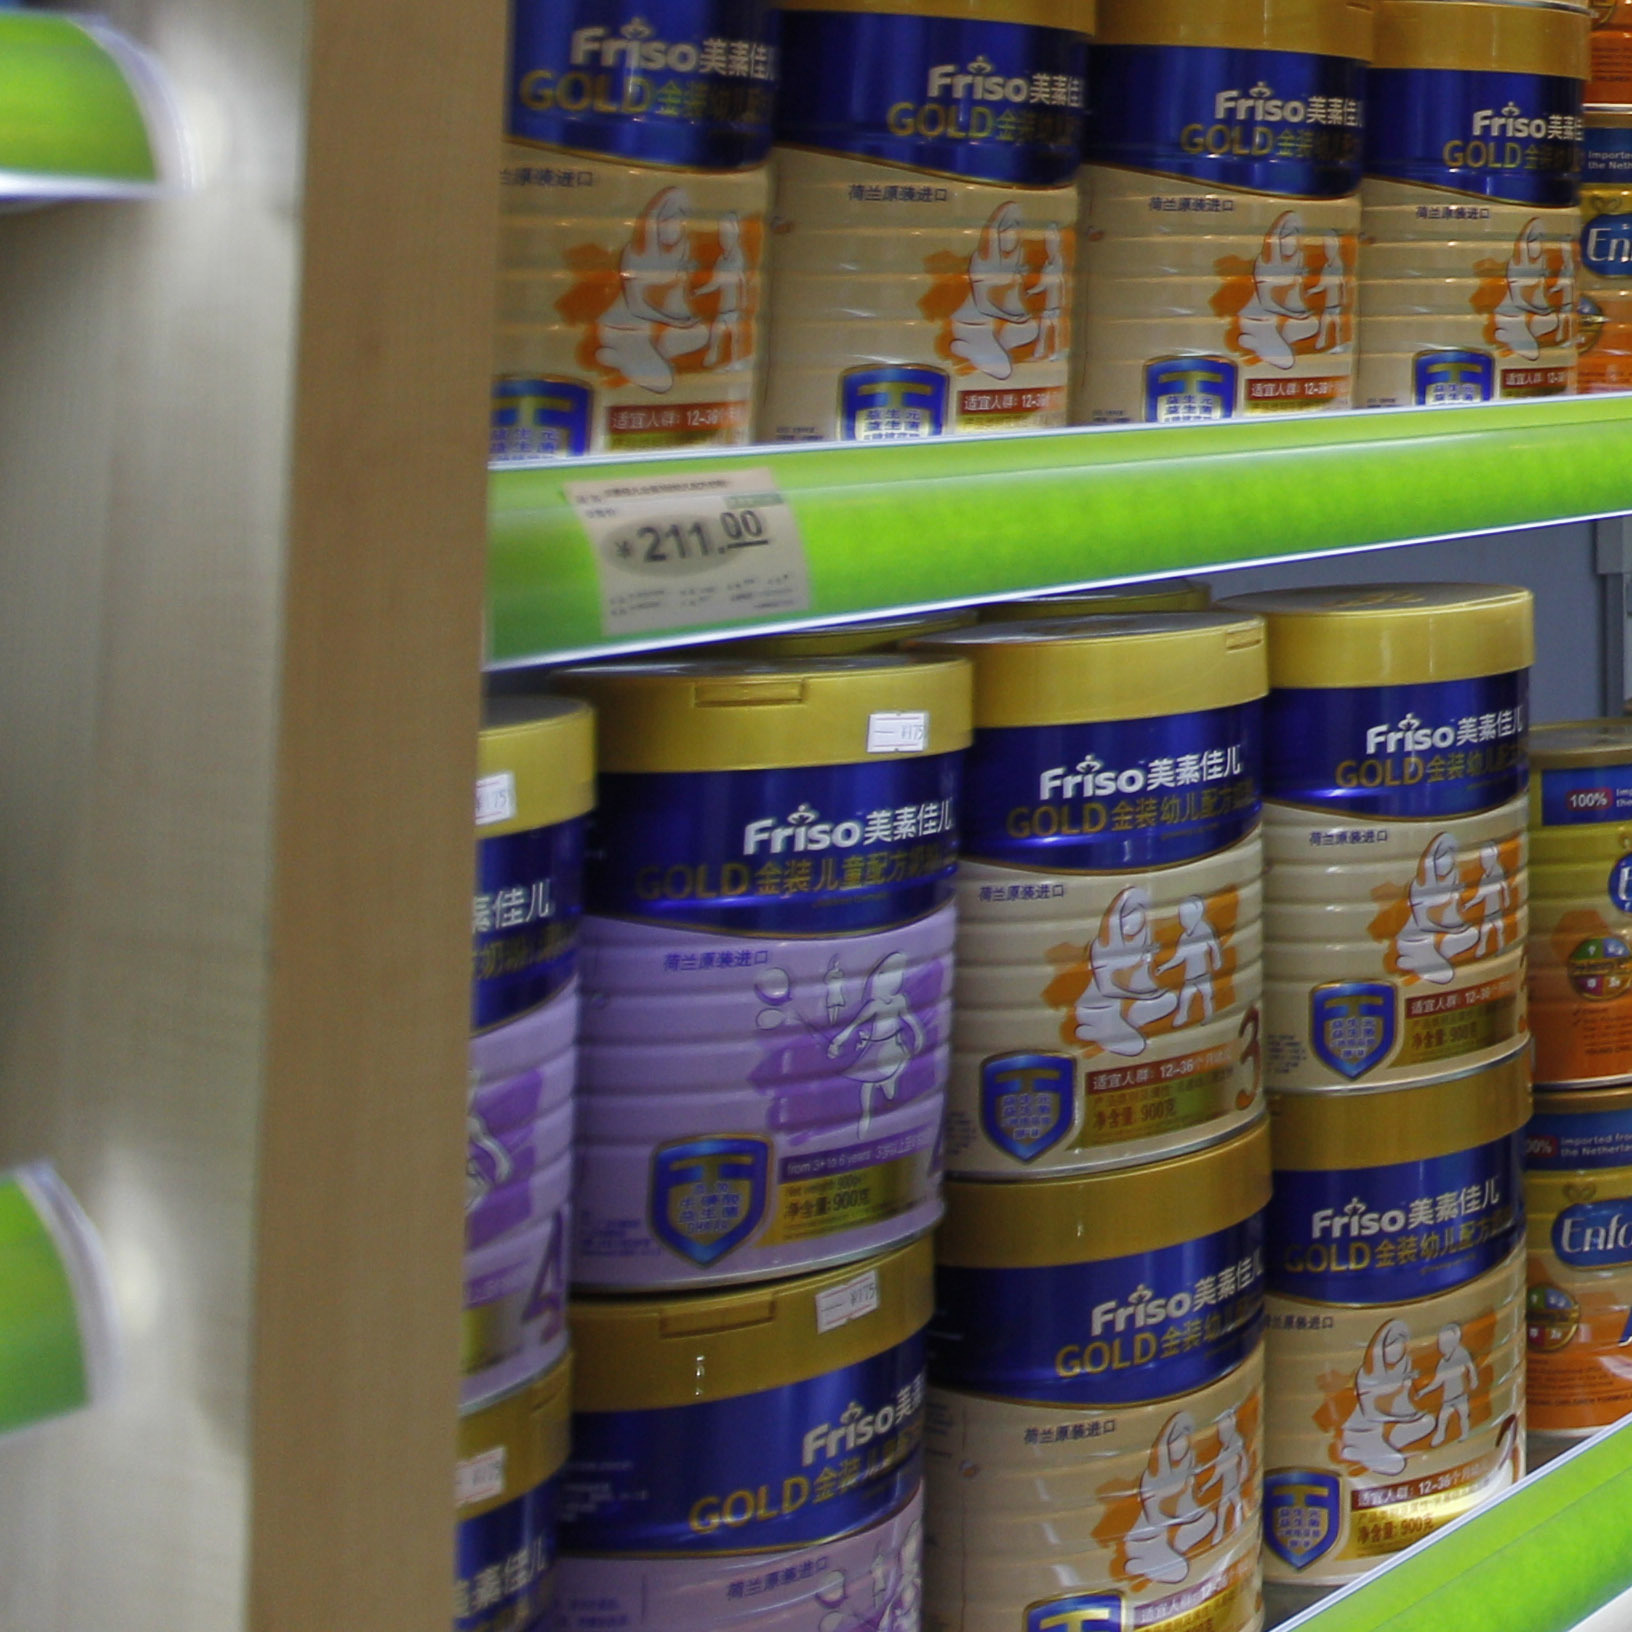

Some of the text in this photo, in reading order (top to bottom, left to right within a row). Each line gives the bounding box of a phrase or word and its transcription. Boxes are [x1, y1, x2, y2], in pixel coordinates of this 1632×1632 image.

[570, 27, 699, 75] Friso
[927, 63, 1028, 103] Friso
[1214, 89, 1304, 123] Friso
[1472, 109, 1546, 139] Friso
[1366, 720, 1454, 754] Friso
[1040, 746, 1240, 800] Friso 美素佳儿
[1570, 793, 1607, 807] 100%
[742, 800, 952, 856] Friso 美素佳儿
[1313, 1186, 1499, 1240] Friso 美素佳儿
[1091, 1292, 1190, 1338] Friso
[803, 1413, 896, 1465] Friso
